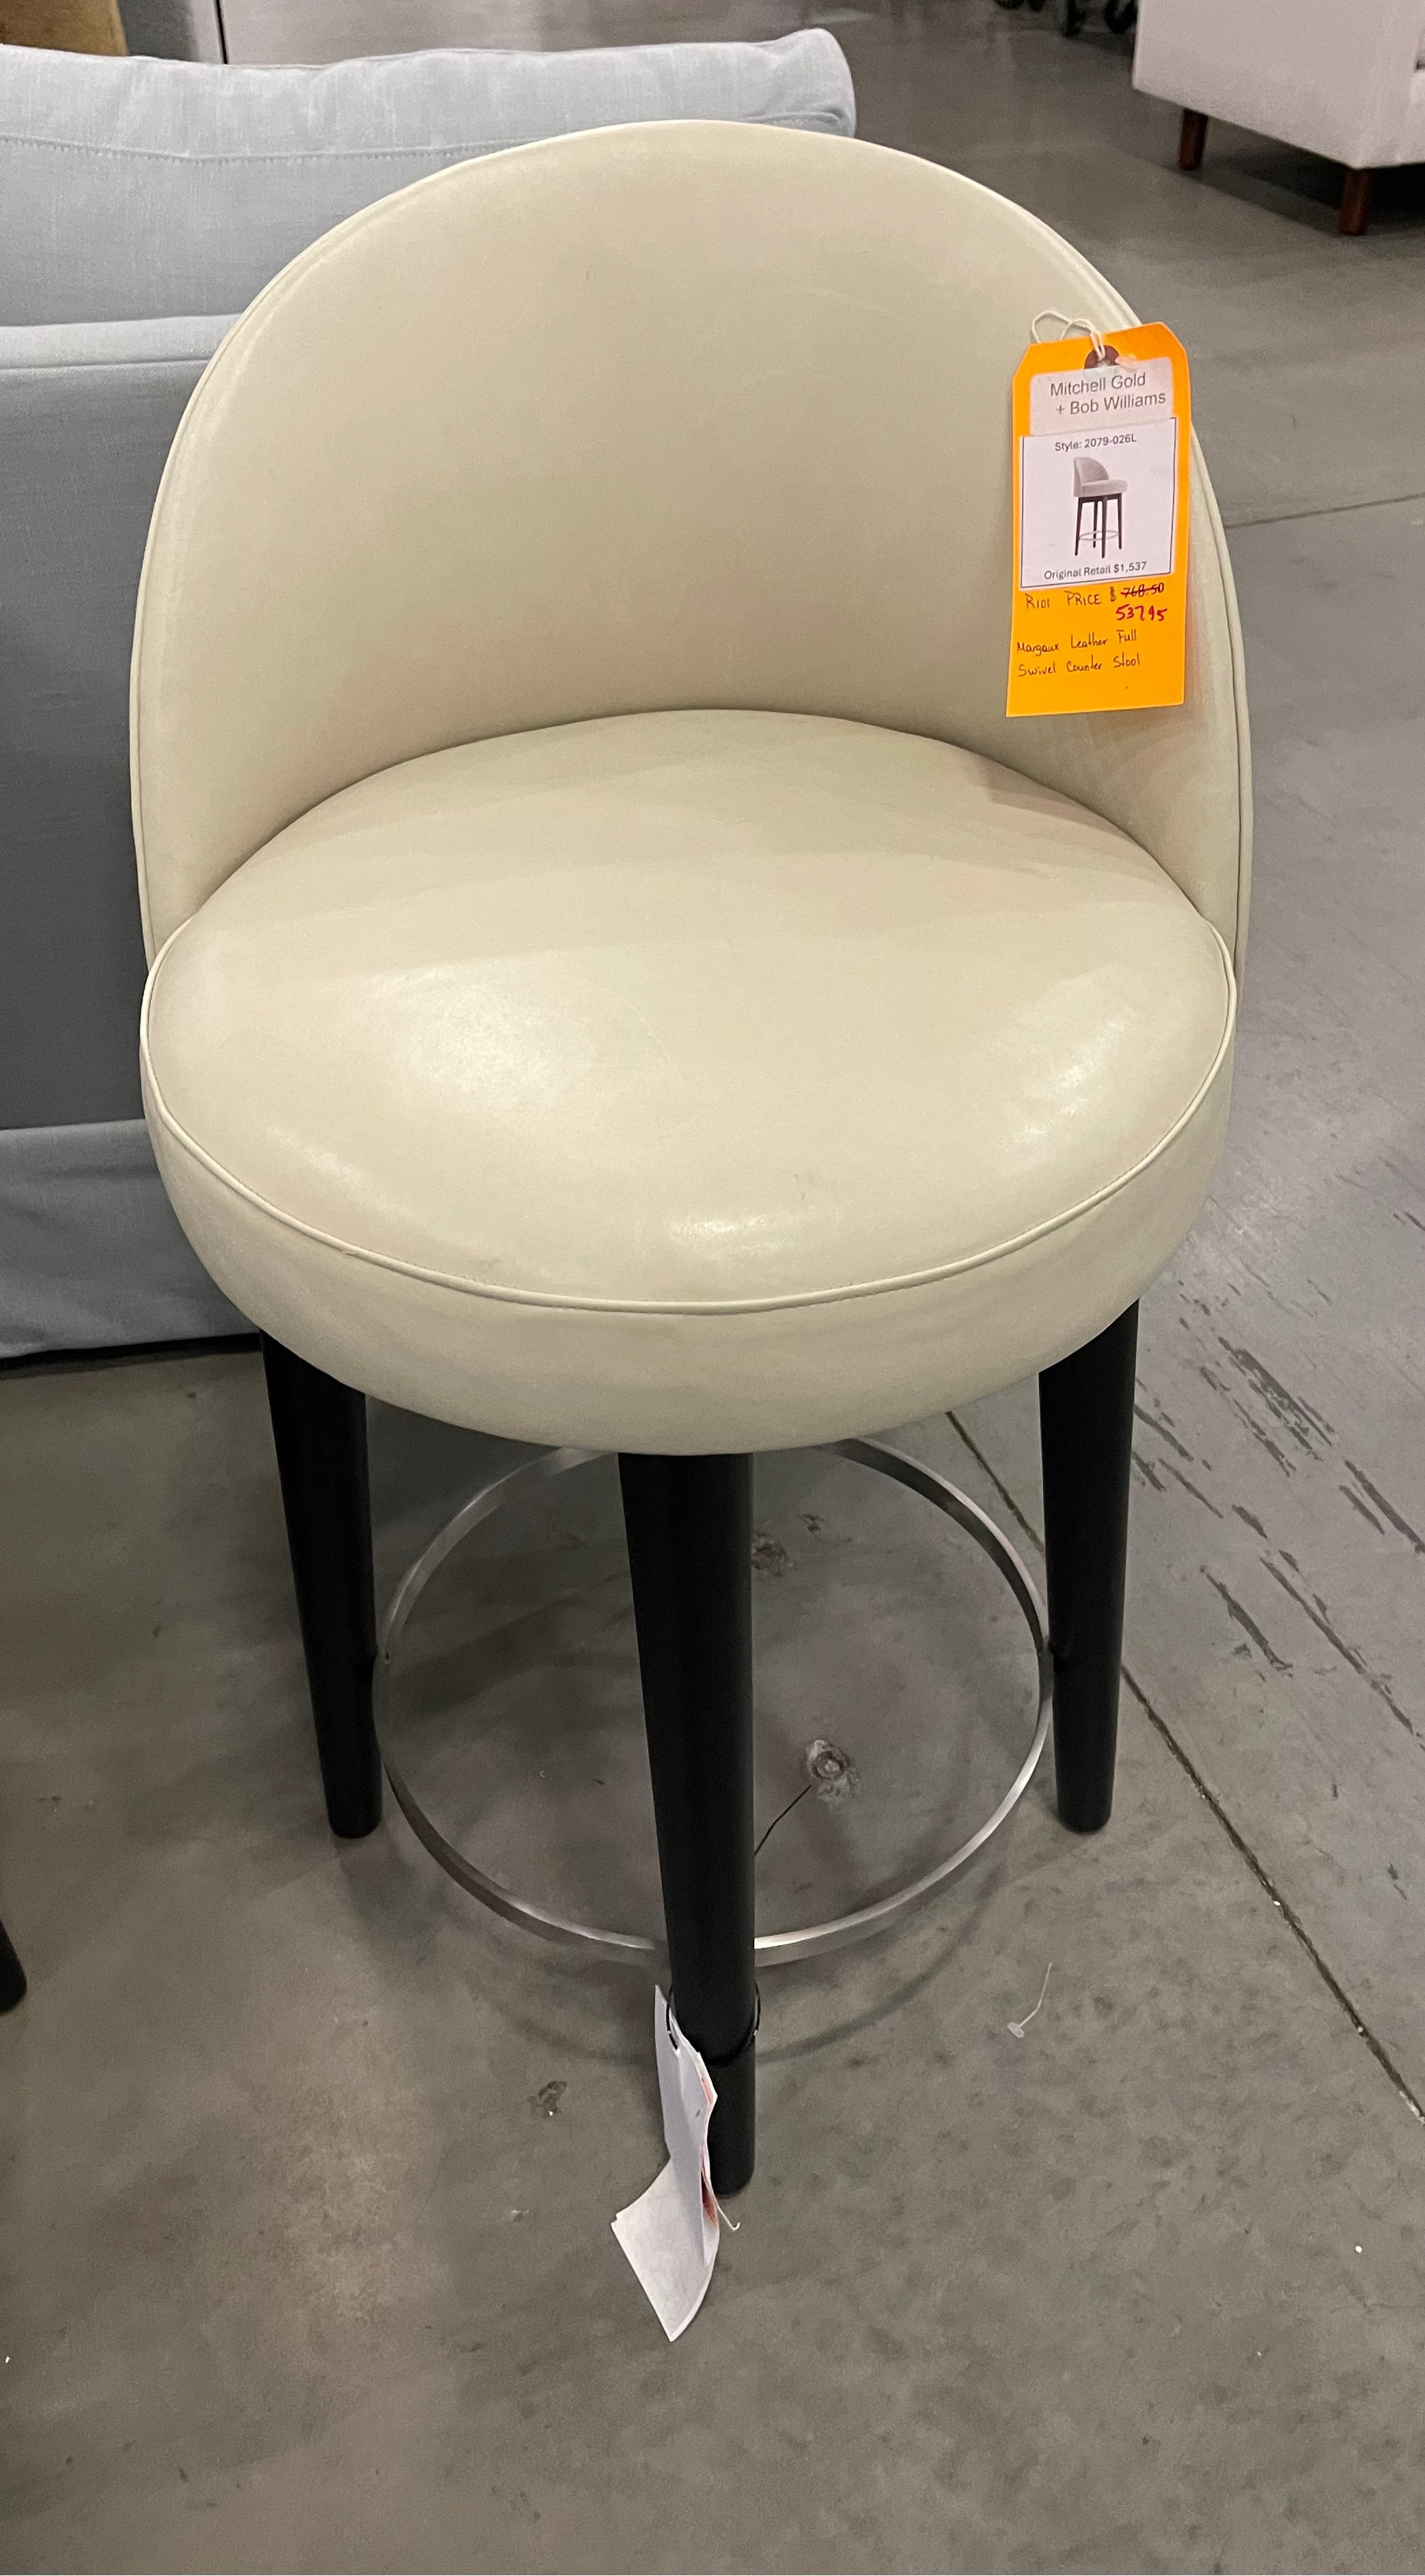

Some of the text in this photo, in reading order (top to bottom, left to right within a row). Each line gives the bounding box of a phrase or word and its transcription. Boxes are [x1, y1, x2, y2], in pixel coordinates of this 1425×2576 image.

[1050, 372, 1146, 397] Mitchell Gold
[1056, 392, 1166, 415] + Bob Williams
[1055, 433, 1137, 452] Style: 2079-026L
[1044, 561, 1147, 580] Original Retail $1,537
[1064, 590, 1102, 606] PRICE
[1016, 628, 1137, 657] Margaux Leather Full
[1018, 652, 1140, 677] Swivel Counter Stool
